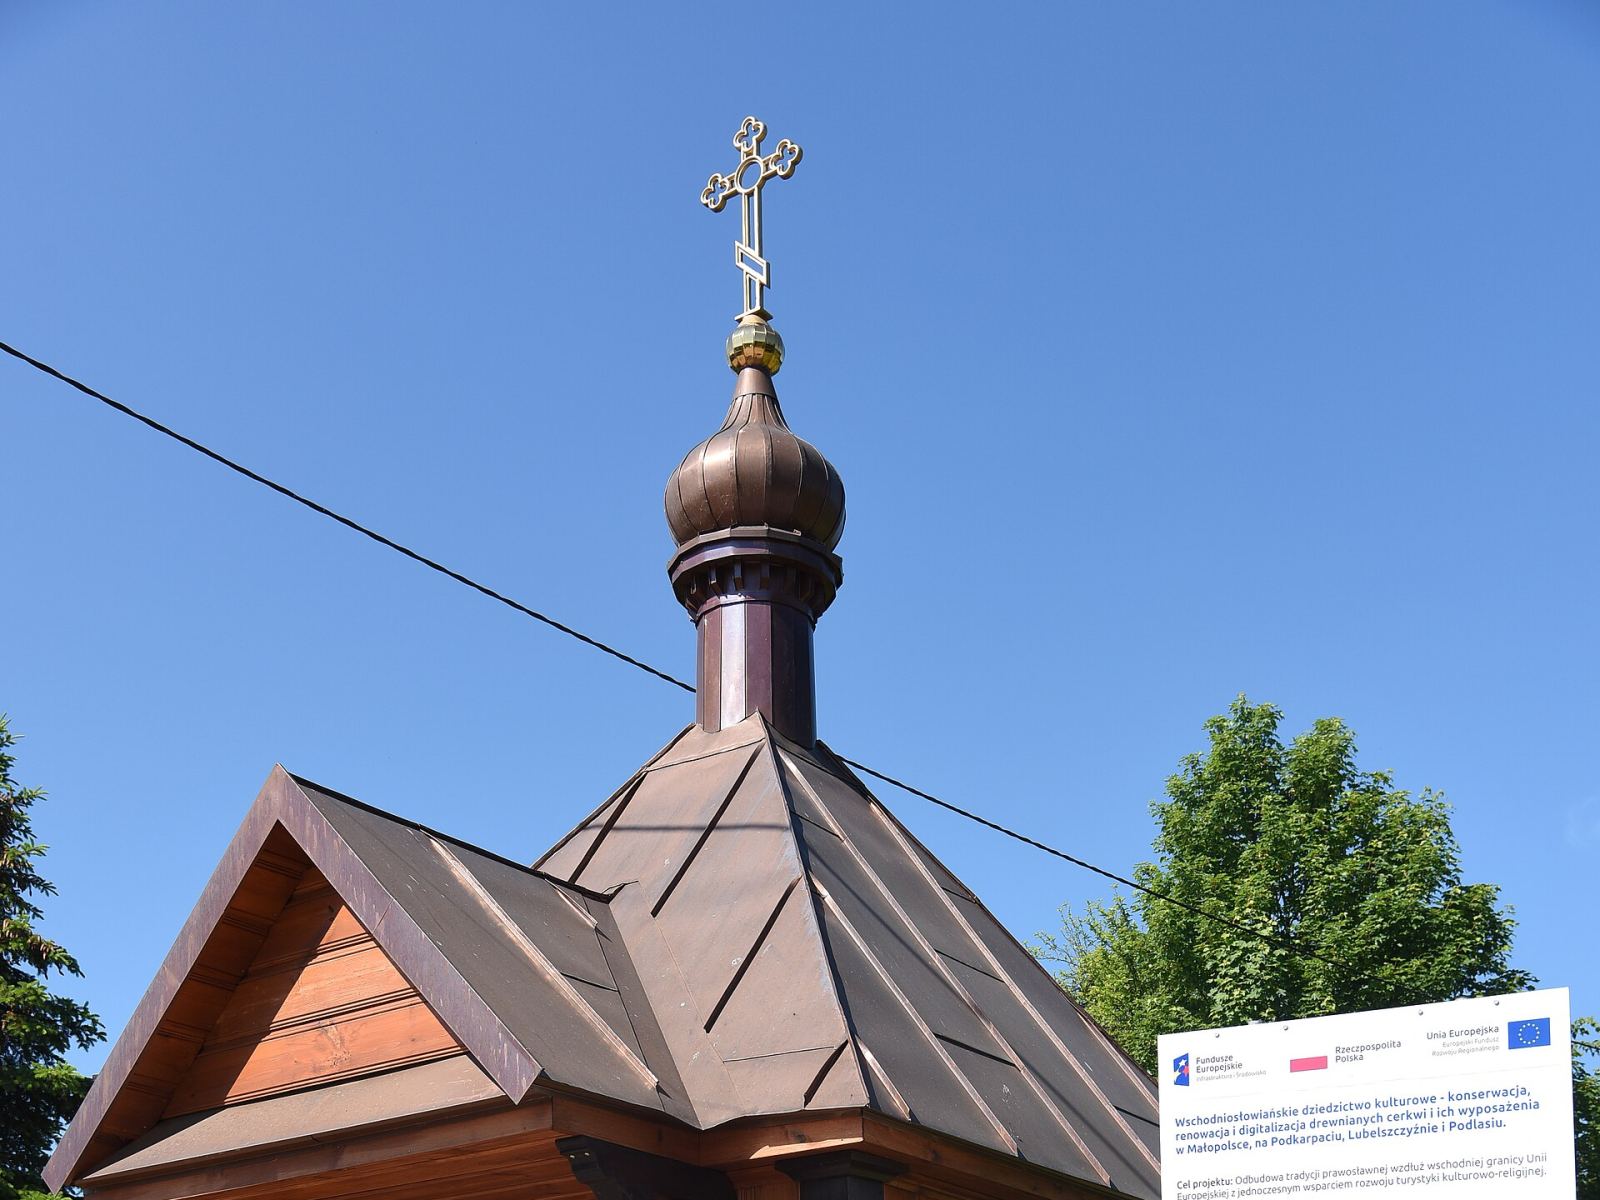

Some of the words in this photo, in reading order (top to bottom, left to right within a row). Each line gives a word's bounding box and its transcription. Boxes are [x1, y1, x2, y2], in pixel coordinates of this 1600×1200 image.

[1427, 1030, 1447, 1040] Unia
[1449, 1026, 1500, 1039] Europejska
[1196, 1054, 1234, 1065] Fundusze
[1336, 1040, 1401, 1055] Rzeczpospolita
[1336, 1053, 1364, 1063] Polska
[1196, 1062, 1243, 1074] Europejskie
[1175, 1107, 1298, 1127] Wschodniosłowiańskie
[1302, 1102, 1370, 1116] dziedzictwo
[1375, 1094, 1436, 1108] kulturowe
[1449, 1085, 1531, 1102] konserwacja,
[1176, 1128, 1229, 1141] renowacja
[1239, 1120, 1306, 1137] digitalizacja
[1310, 1110, 1383, 1129] drewnianych
[1387, 1108, 1427, 1122] cerkwi
[1437, 1105, 1454, 1118] ich
[1458, 1099, 1540, 1119] wyposażenia
[1188, 1140, 1252, 1154] Małopolsce,
[1255, 1139, 1268, 1148] na
[1272, 1131, 1345, 1147] Podkarpaciu,
[1348, 1124, 1438, 1140] Lubelszczyźnie
[1449, 1118, 1506, 1132] Podlasiu.
[1177, 1180, 1191, 1190] Cel
[1193, 1178, 1233, 1190] projektu:
[1235, 1174, 1284, 1185] Odbudowa
[1286, 1170, 1320, 1182] tradycji
[1322, 1164, 1388, 1179] prawosławnej
[1391, 1162, 1424, 1173] wzdłuż
[1427, 1158, 1484, 1170] wschodniej
[1487, 1155, 1524, 1167] granicy
[1527, 1152, 1547, 1164] Unii
[1177, 1189, 1229, 1200] Europejskiej
[1238, 1184, 1300, 1199] jednoczesnym
[1303, 1181, 1353, 1193] wsparciem
[1355, 1176, 1394, 1188] rozwoju
[1397, 1172, 1440, 1187] turystyki
[1442, 1166, 1547, 1182] kulturowo-religijnej.
